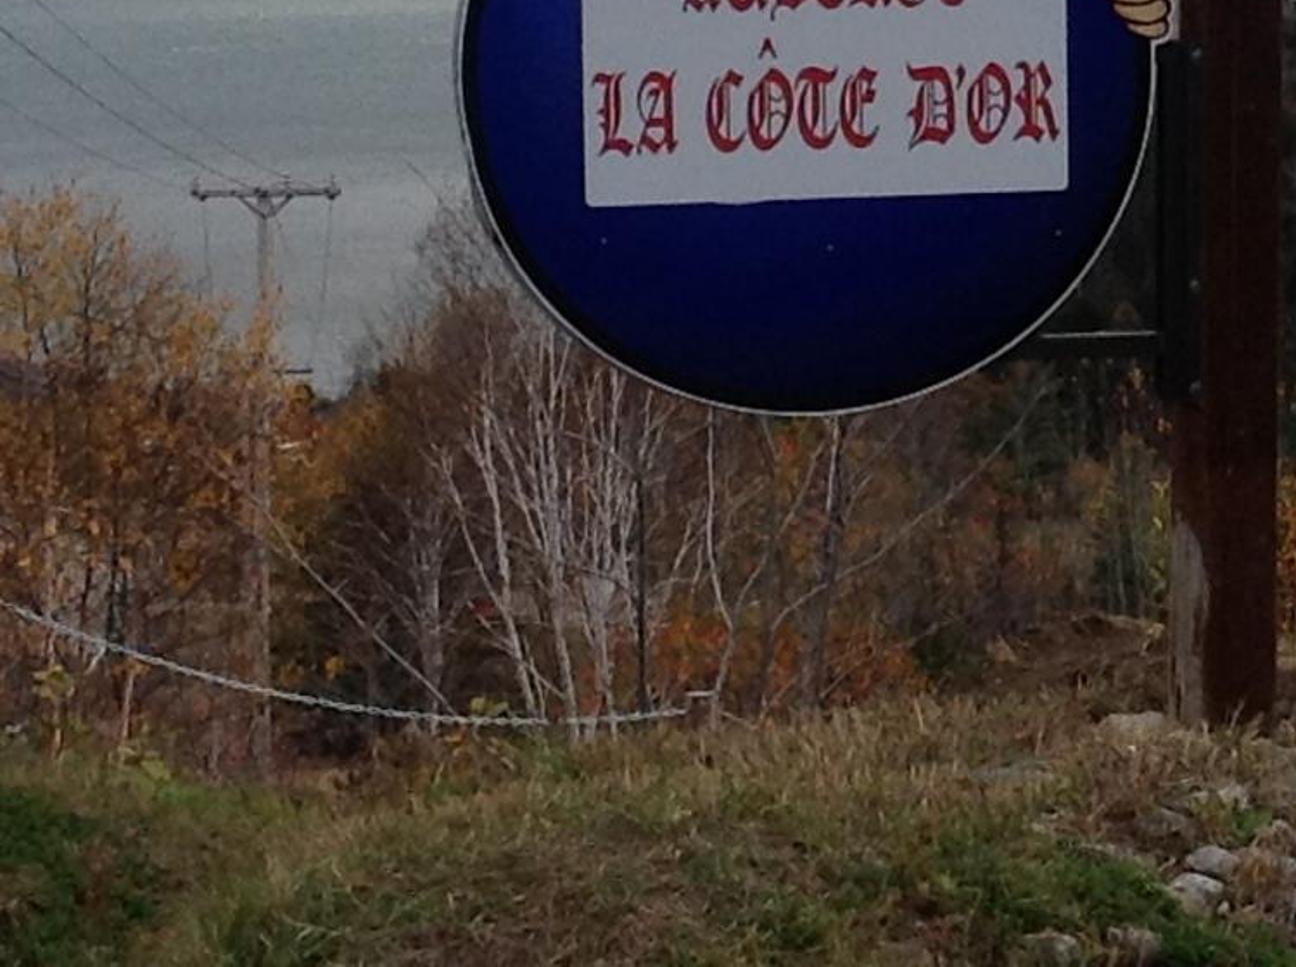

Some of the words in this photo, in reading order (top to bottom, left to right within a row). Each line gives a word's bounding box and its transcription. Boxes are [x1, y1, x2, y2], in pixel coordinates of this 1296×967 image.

[592, 70, 679, 156] LA
[705, 38, 881, 153] CÔTE
[907, 61, 1060, 151] D'OR
